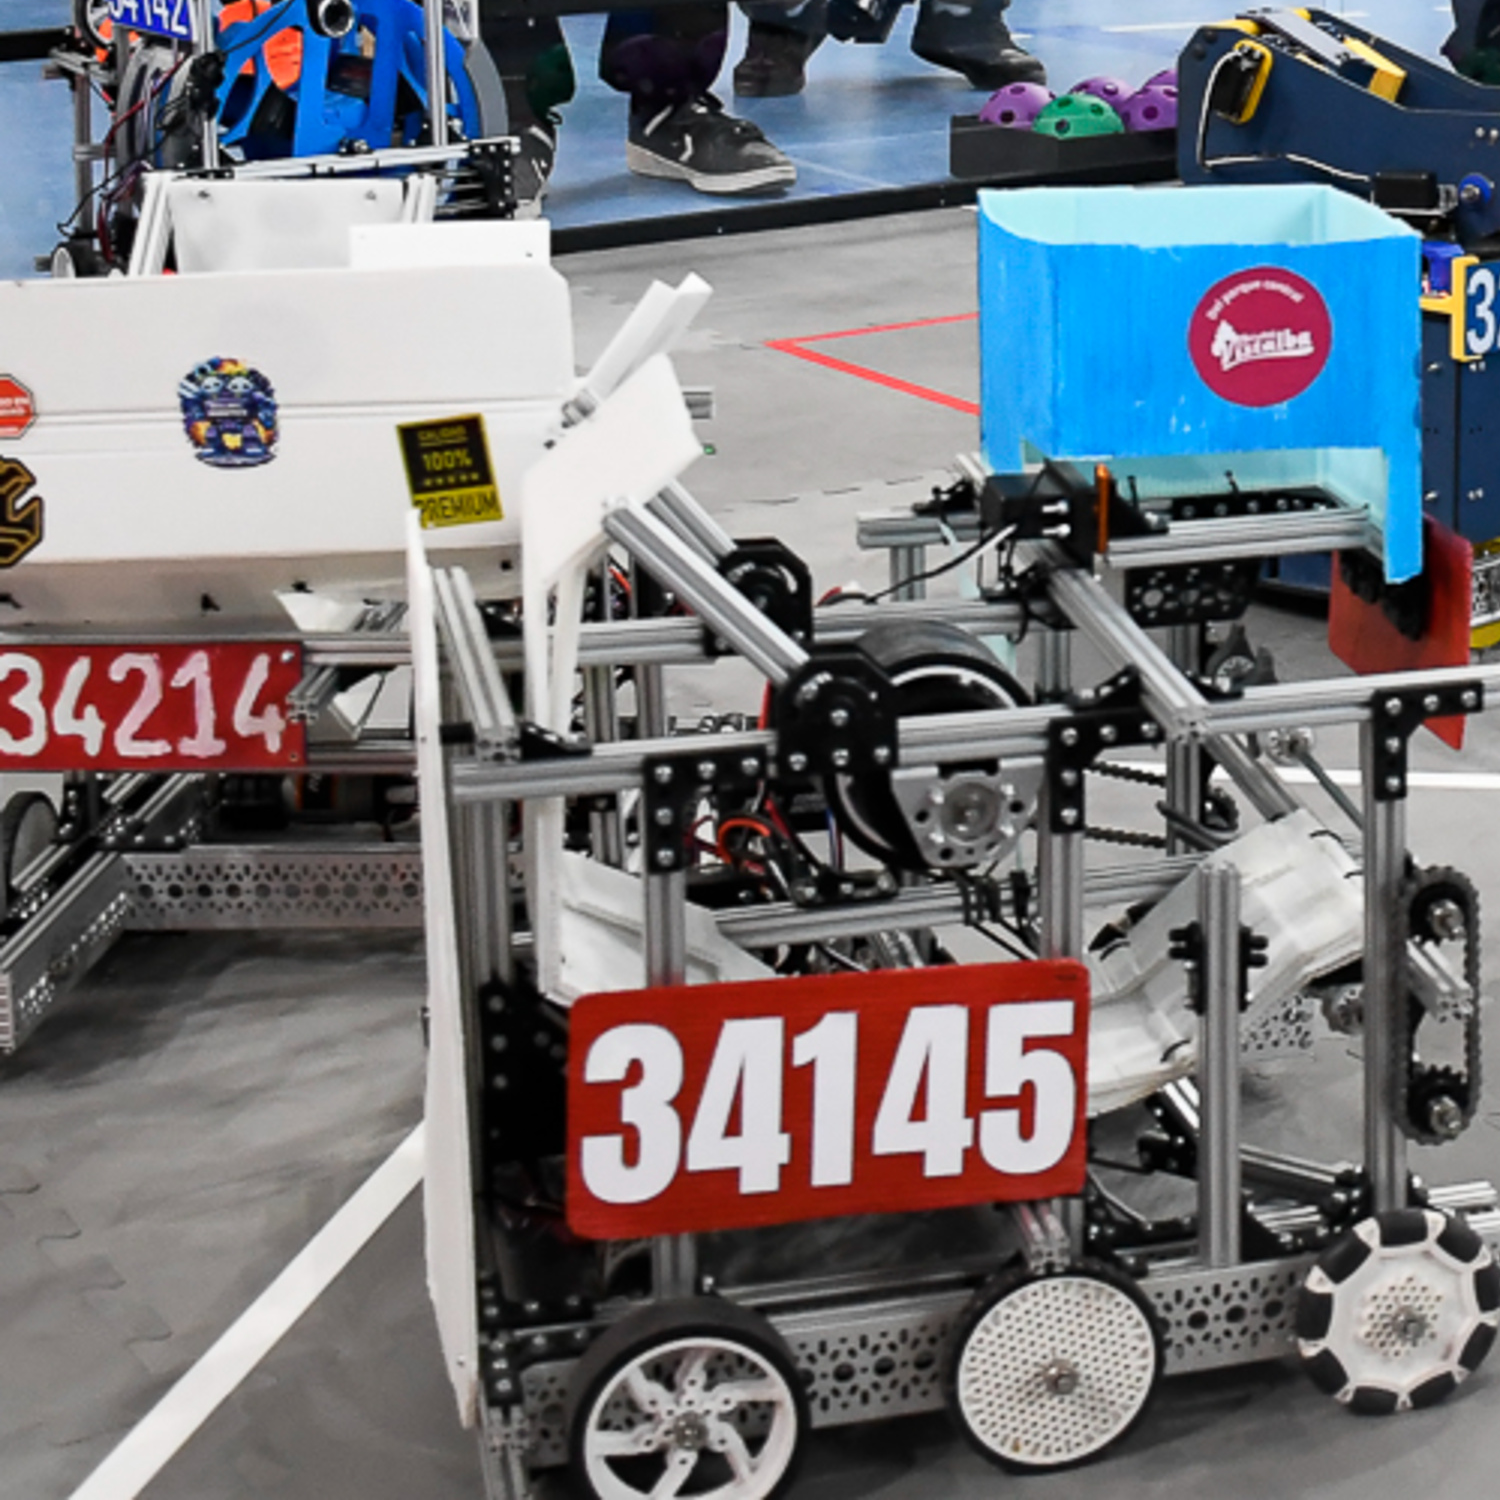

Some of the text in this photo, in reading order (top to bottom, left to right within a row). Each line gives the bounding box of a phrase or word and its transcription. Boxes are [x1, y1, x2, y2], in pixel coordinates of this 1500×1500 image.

[422, 447, 473, 471] 100%
[0, 649, 287, 759] 34214
[579, 999, 1077, 1205] 34145
